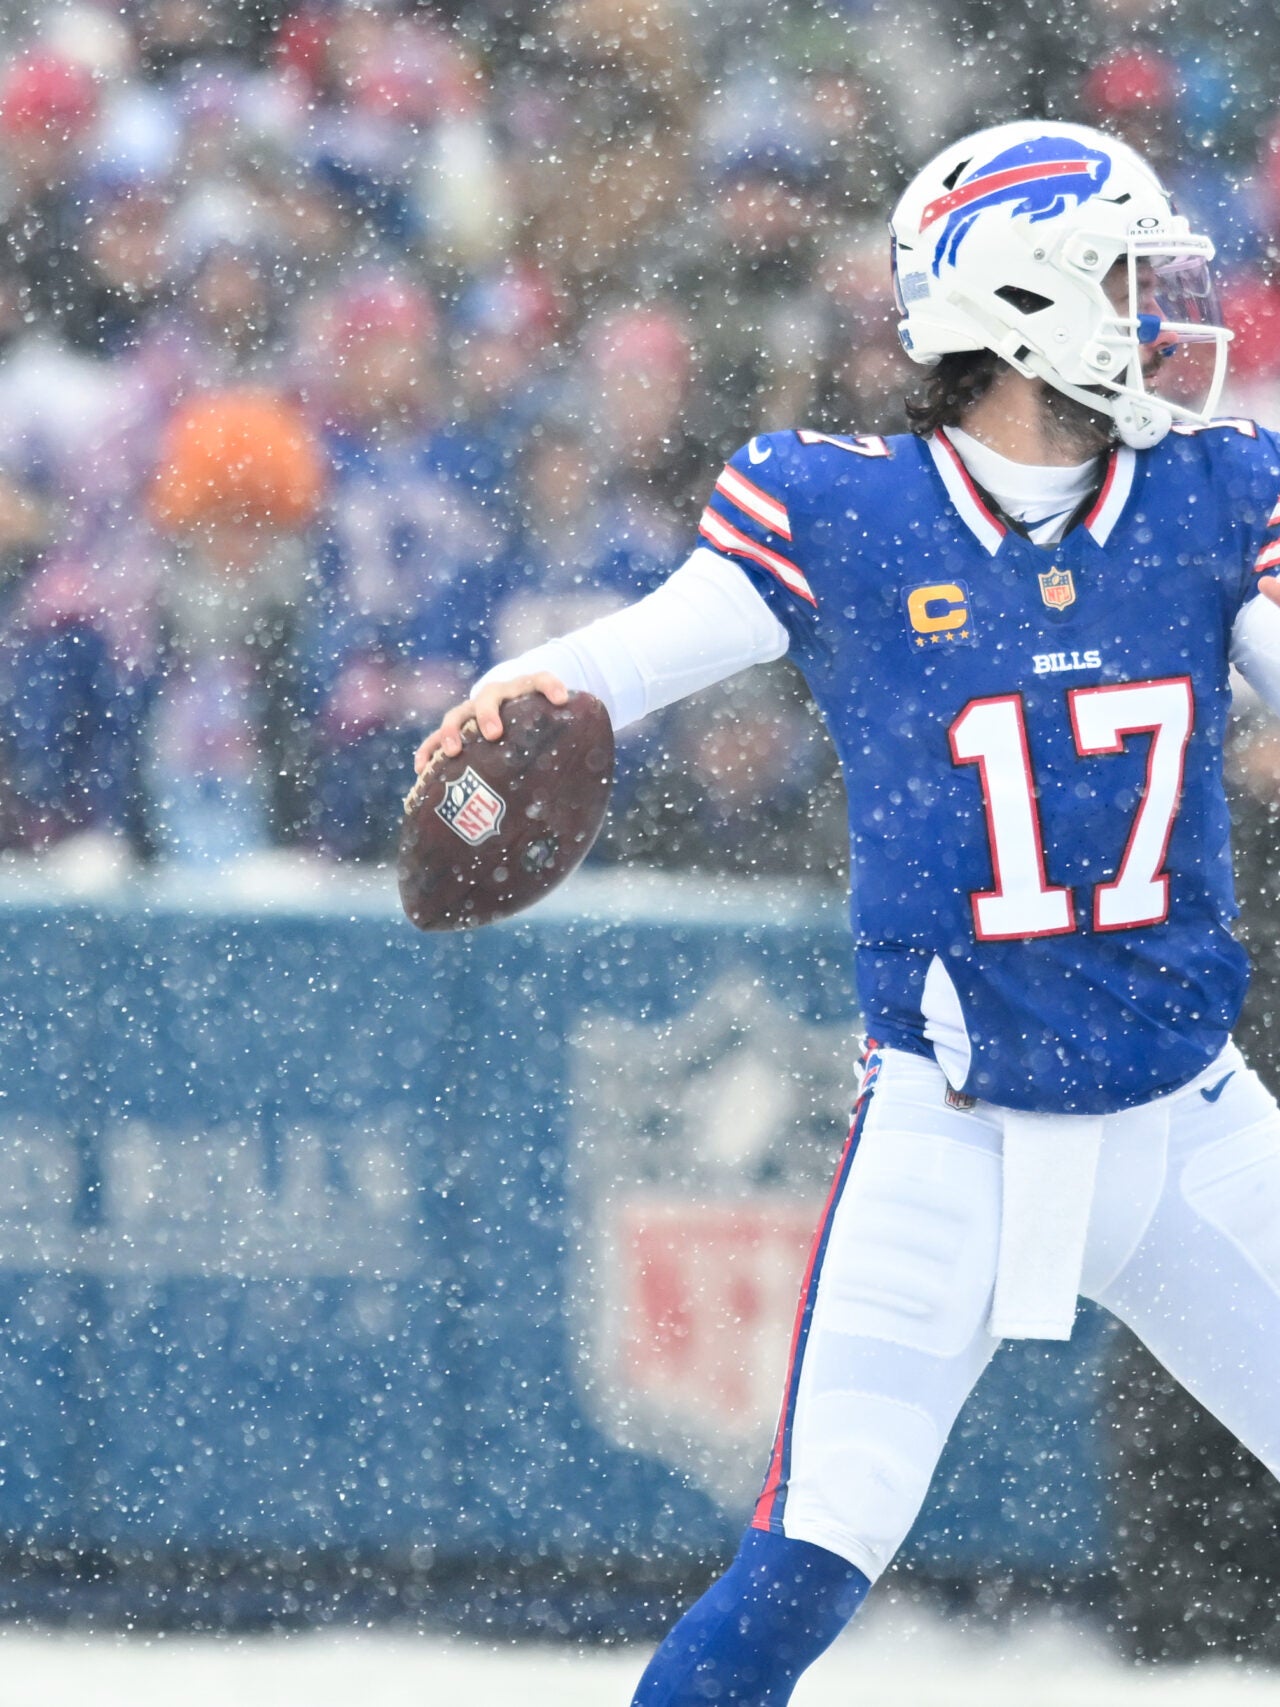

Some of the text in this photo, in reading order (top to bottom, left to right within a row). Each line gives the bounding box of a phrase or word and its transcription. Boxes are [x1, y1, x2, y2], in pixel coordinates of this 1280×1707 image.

[907, 584, 967, 634] C
[1032, 650, 1102, 675] BILLS
[455, 793, 500, 838] NFL
[947, 674, 1195, 942] 17
